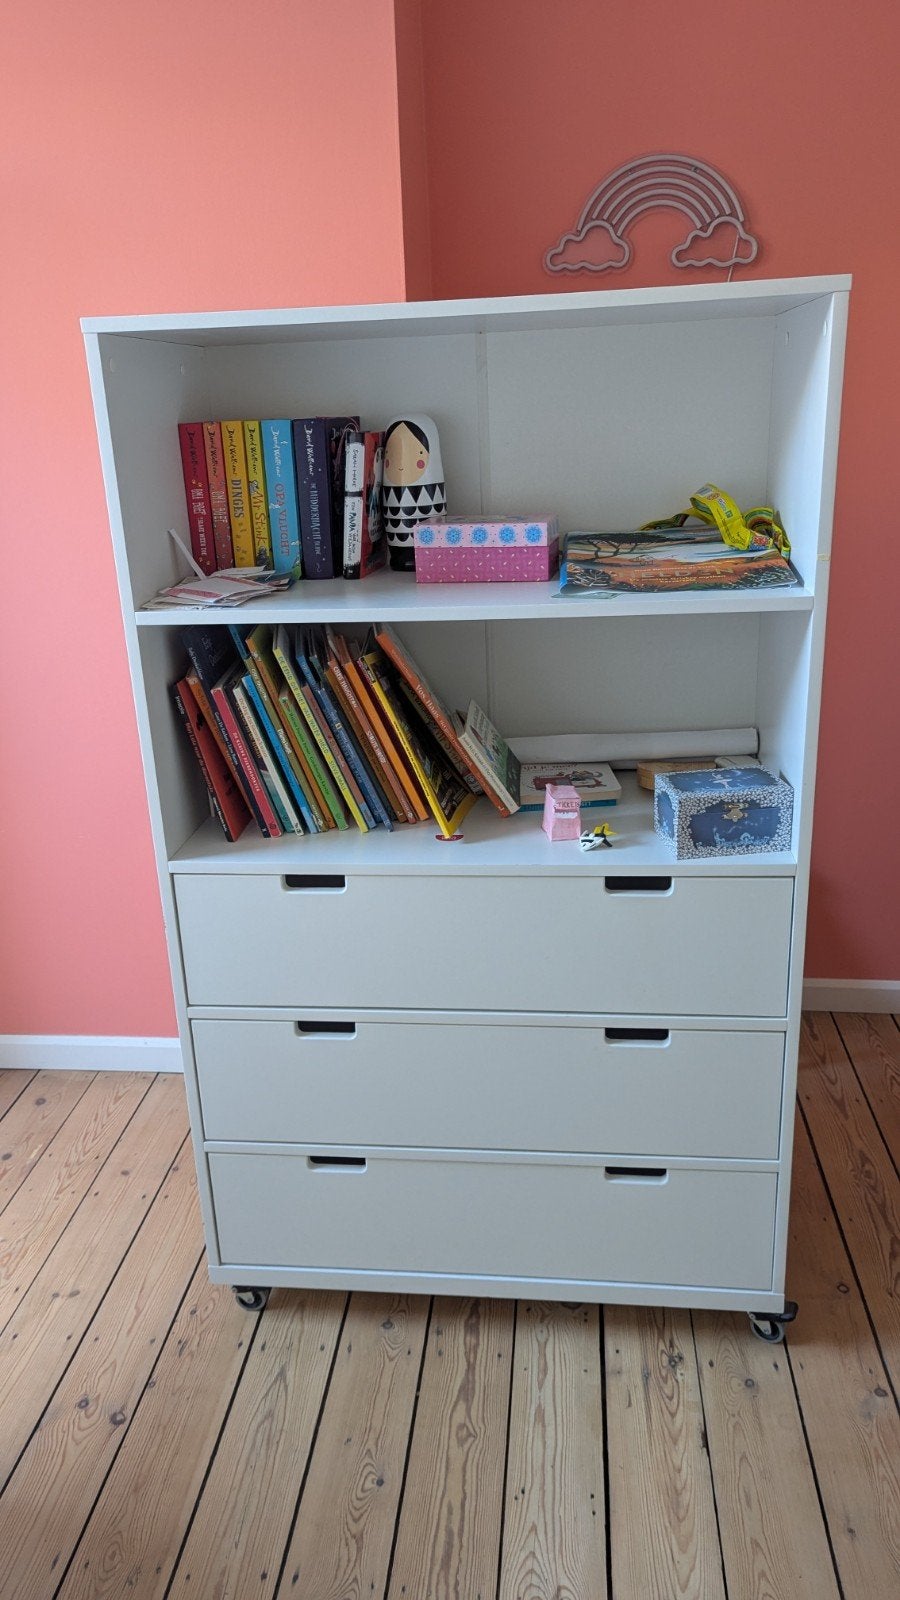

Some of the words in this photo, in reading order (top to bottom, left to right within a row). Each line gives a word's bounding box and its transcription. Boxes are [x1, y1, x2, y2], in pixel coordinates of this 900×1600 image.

[206, 427, 218, 449] David
[225, 424, 236, 448] David
[246, 423, 257, 446] David
[269, 425, 281, 449] David
[302, 423, 314, 447] David
[228, 447, 239, 475] Walliams
[249, 446, 259, 475] Walliams
[229, 478, 245, 519] DINGES
[250, 490, 265, 511] Mr
[273, 482, 286, 506] OPA
[252, 511, 269, 546] Stink
[276, 508, 291, 557] VLUCHT
[347, 512, 357, 532] PANDA
[413, 683, 428, 700] Vos
